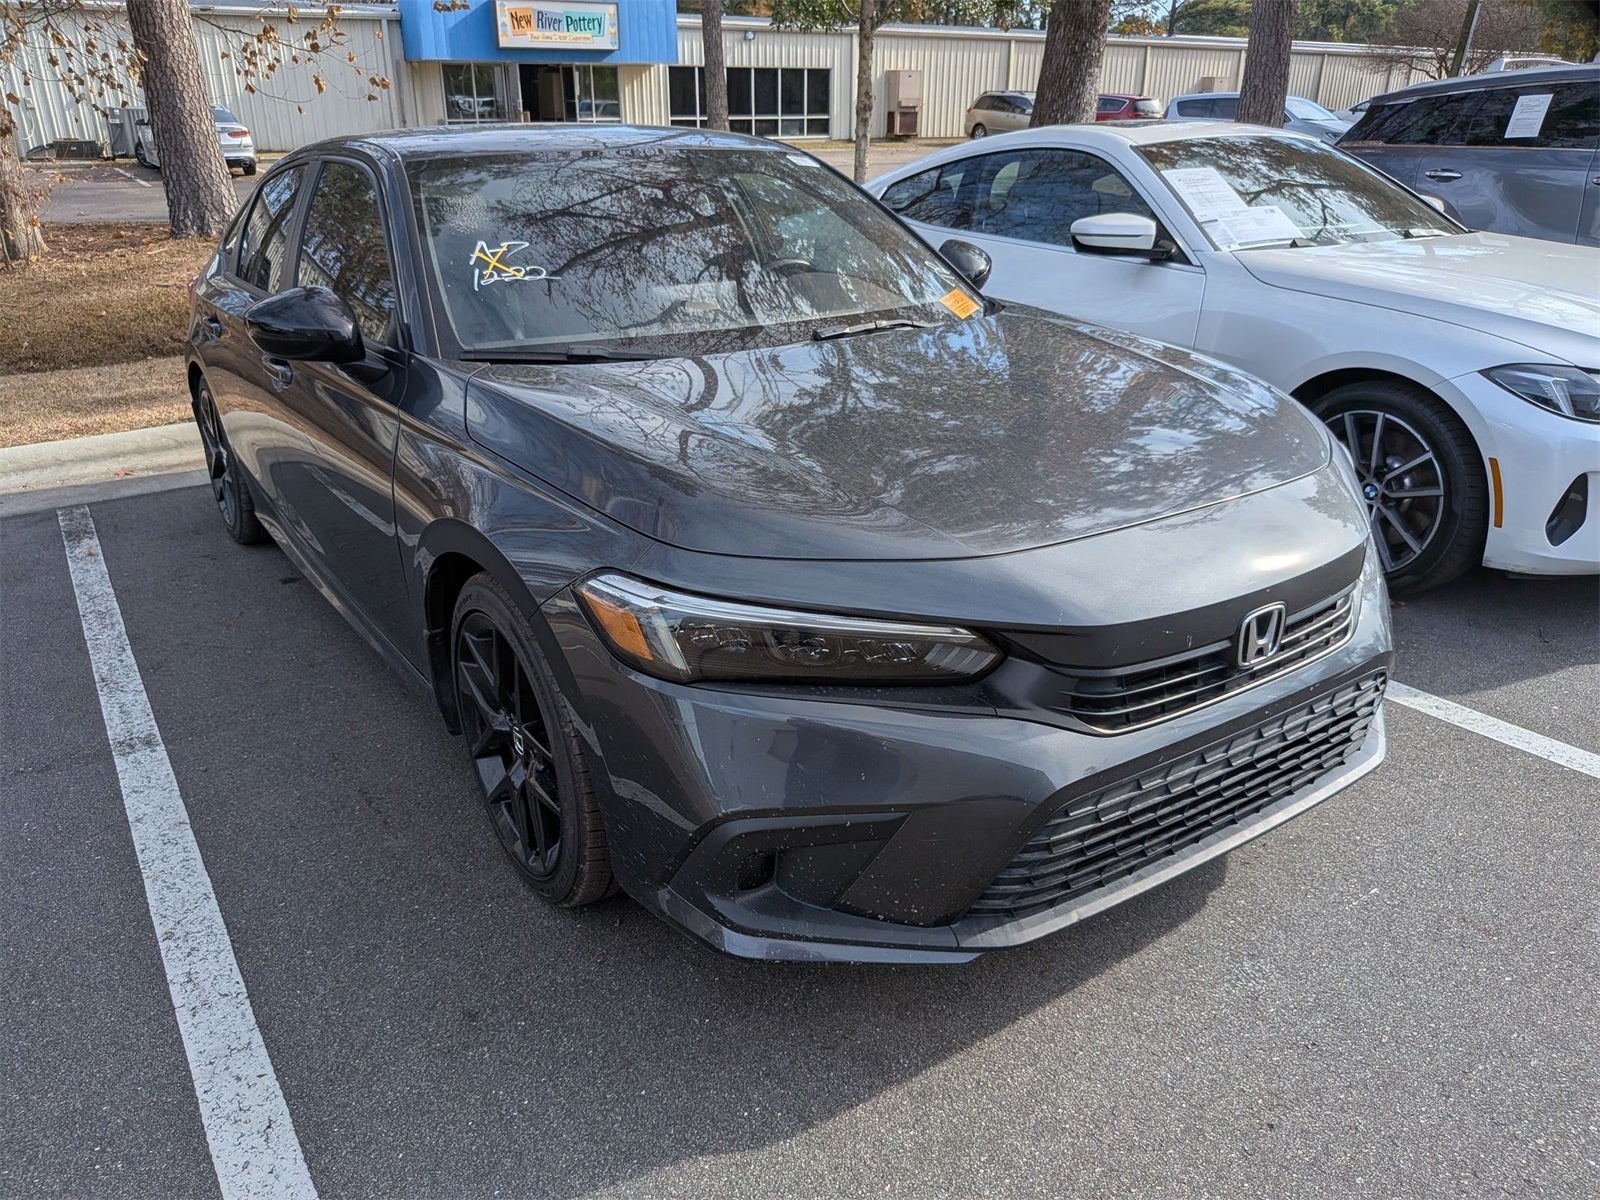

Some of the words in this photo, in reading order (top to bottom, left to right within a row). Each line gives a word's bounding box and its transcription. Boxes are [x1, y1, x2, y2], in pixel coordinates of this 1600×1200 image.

[510, 11, 532, 30] New
[537, 11, 562, 31] River
[565, 15, 602, 34] Pottery
